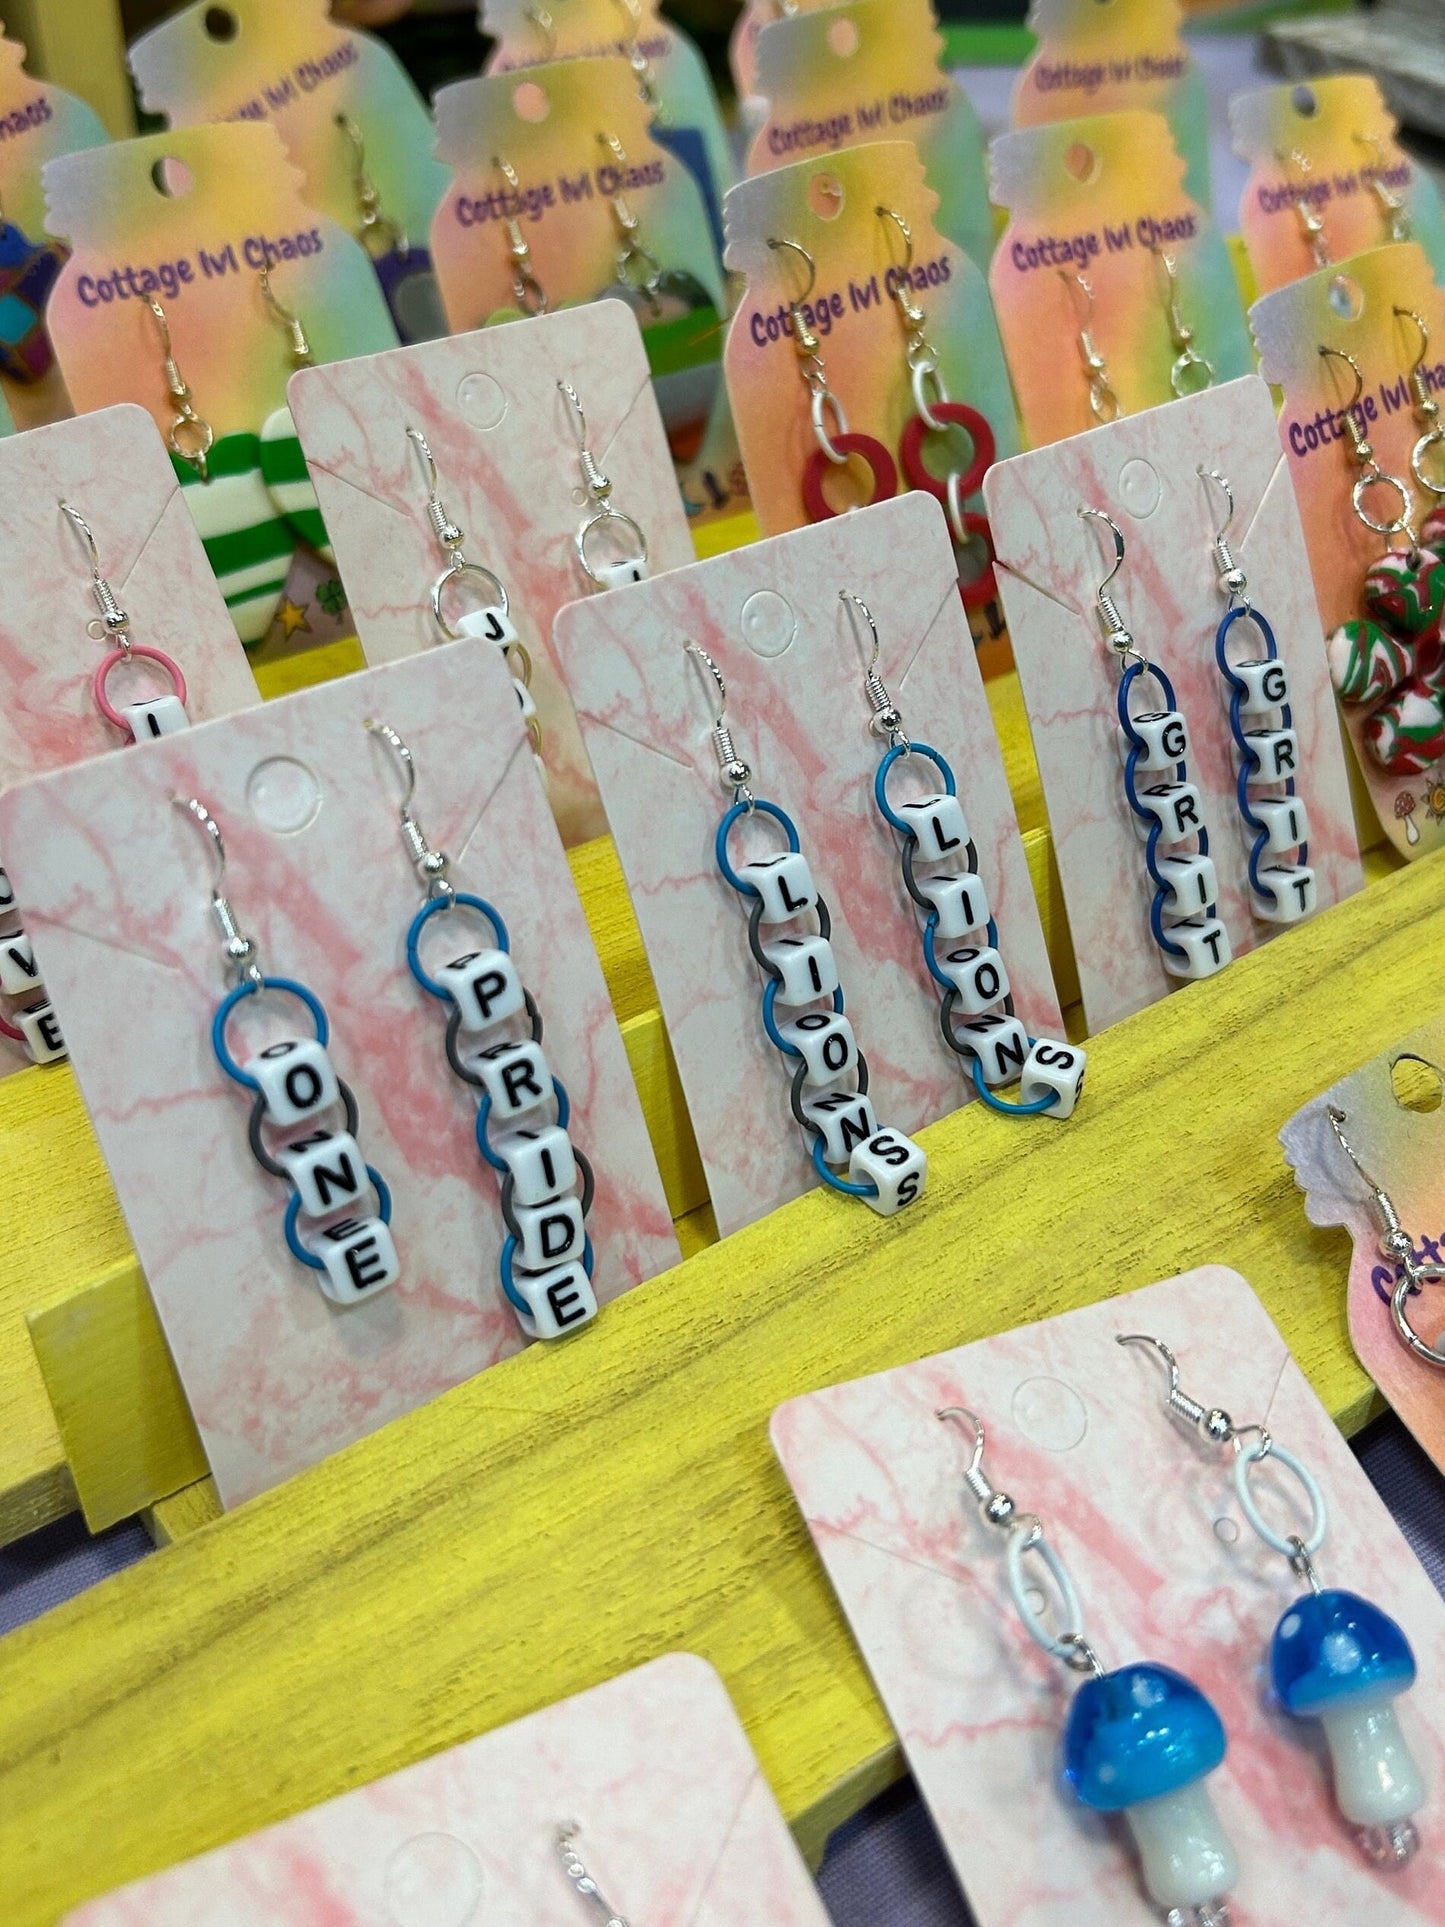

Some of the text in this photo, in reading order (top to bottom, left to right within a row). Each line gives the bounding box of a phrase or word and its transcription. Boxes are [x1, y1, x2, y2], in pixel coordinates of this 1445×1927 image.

[77, 228, 323, 308] Cottage lvl Chaos
[849, 276, 881, 313] lvl
[1012, 213, 1196, 272] Cottage lvl Chaos
[1379, 374, 1410, 415] lvl
[1162, 721, 1221, 965] GRIT
[1262, 667, 1311, 913] GRIT
[285, 1063, 388, 1290] ONE
[473, 970, 587, 1328] PRIDE
